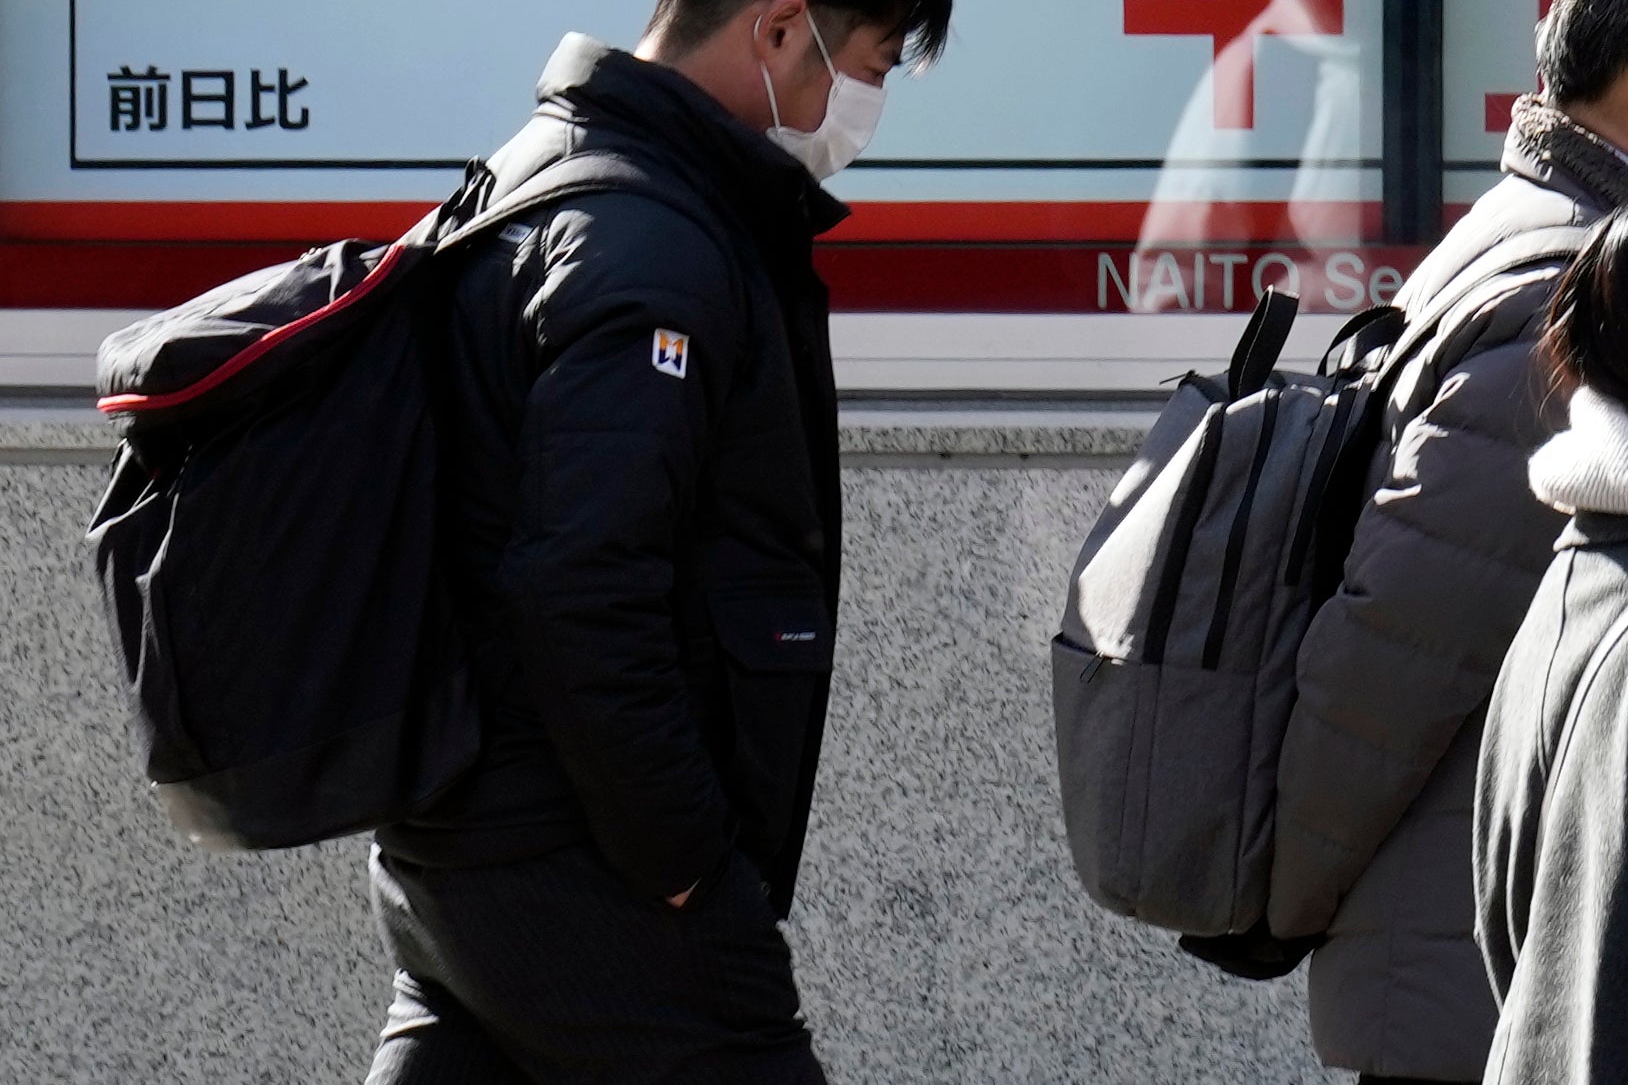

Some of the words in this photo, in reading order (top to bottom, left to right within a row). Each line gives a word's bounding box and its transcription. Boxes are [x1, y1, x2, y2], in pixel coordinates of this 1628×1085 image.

[106, 65, 310, 133] 前日比
[1097, 252, 1300, 310] NAITO
